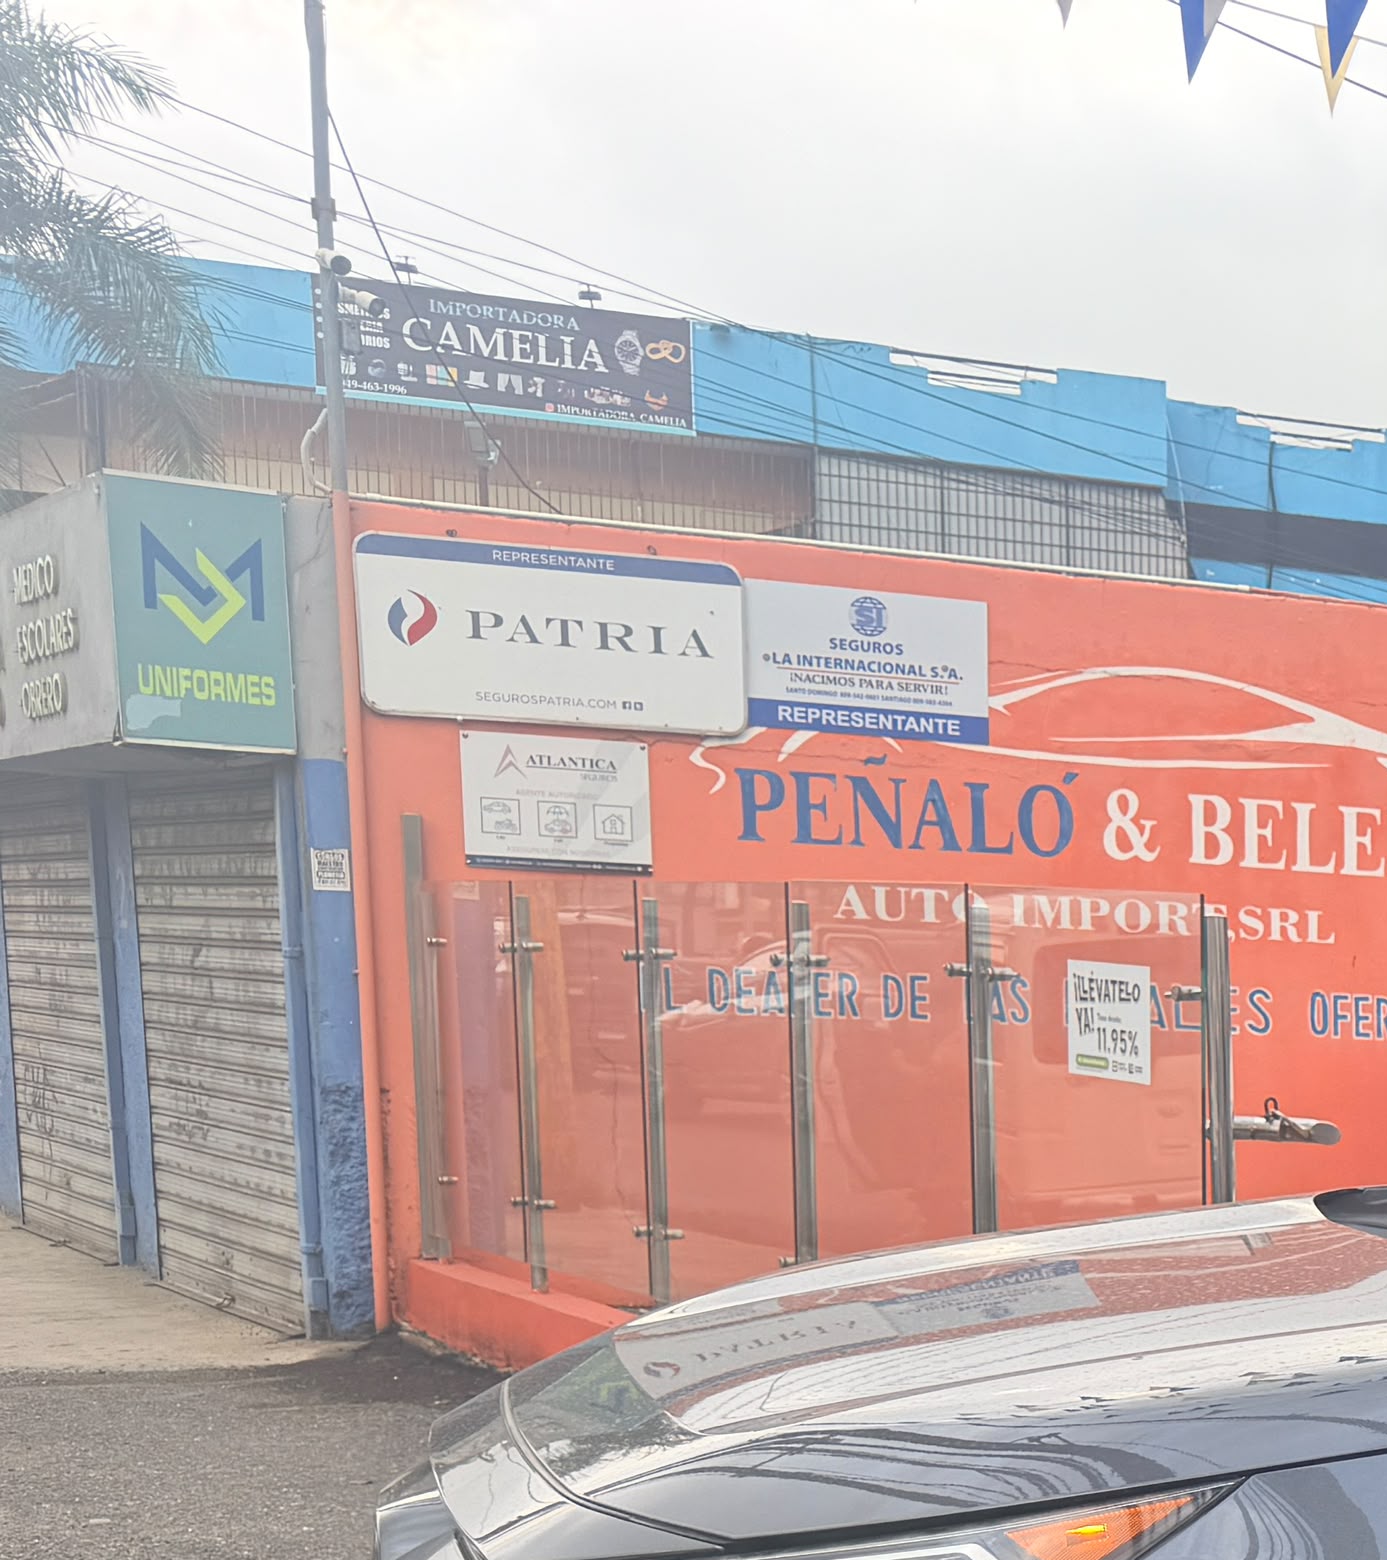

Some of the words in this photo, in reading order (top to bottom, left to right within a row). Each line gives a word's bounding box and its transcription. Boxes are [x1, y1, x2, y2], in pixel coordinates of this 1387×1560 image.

[429, 299, 580, 331] IMPORTADORA
[402, 317, 609, 373] CAMELIA
[492, 550, 615, 570] REPRESENTANTE
[13, 555, 54, 604] MEDICO
[17, 608, 75, 663] ESCOLARES
[465, 609, 714, 659] PATRIA
[829, 638, 904, 656] SEGUROS
[772, 652, 793, 666] LA
[797, 655, 926, 678] INTERNACIONAL
[21, 673, 62, 719] OBRERO
[138, 663, 276, 706] UNIFORMES
[789, 672, 855, 688] ¡NACIMOS
[859, 678, 894, 691] PARA
[897, 682, 949, 696] SERVIR!
[475, 691, 617, 710] SEGUROSPATRIA.COM
[777, 705, 961, 735] REPRESENTANTE
[526, 754, 617, 771] ATLANTICA
[733, 754, 1080, 858] PEÑALÓ
[1103, 787, 1160, 862] &
[706, 966, 861, 1021] DEAER
[881, 972, 930, 1023] DE
[964, 975, 1031, 1025] AS
[1075, 1007, 1095, 1037] YA!
[1097, 1027, 1139, 1057] 11.95%
